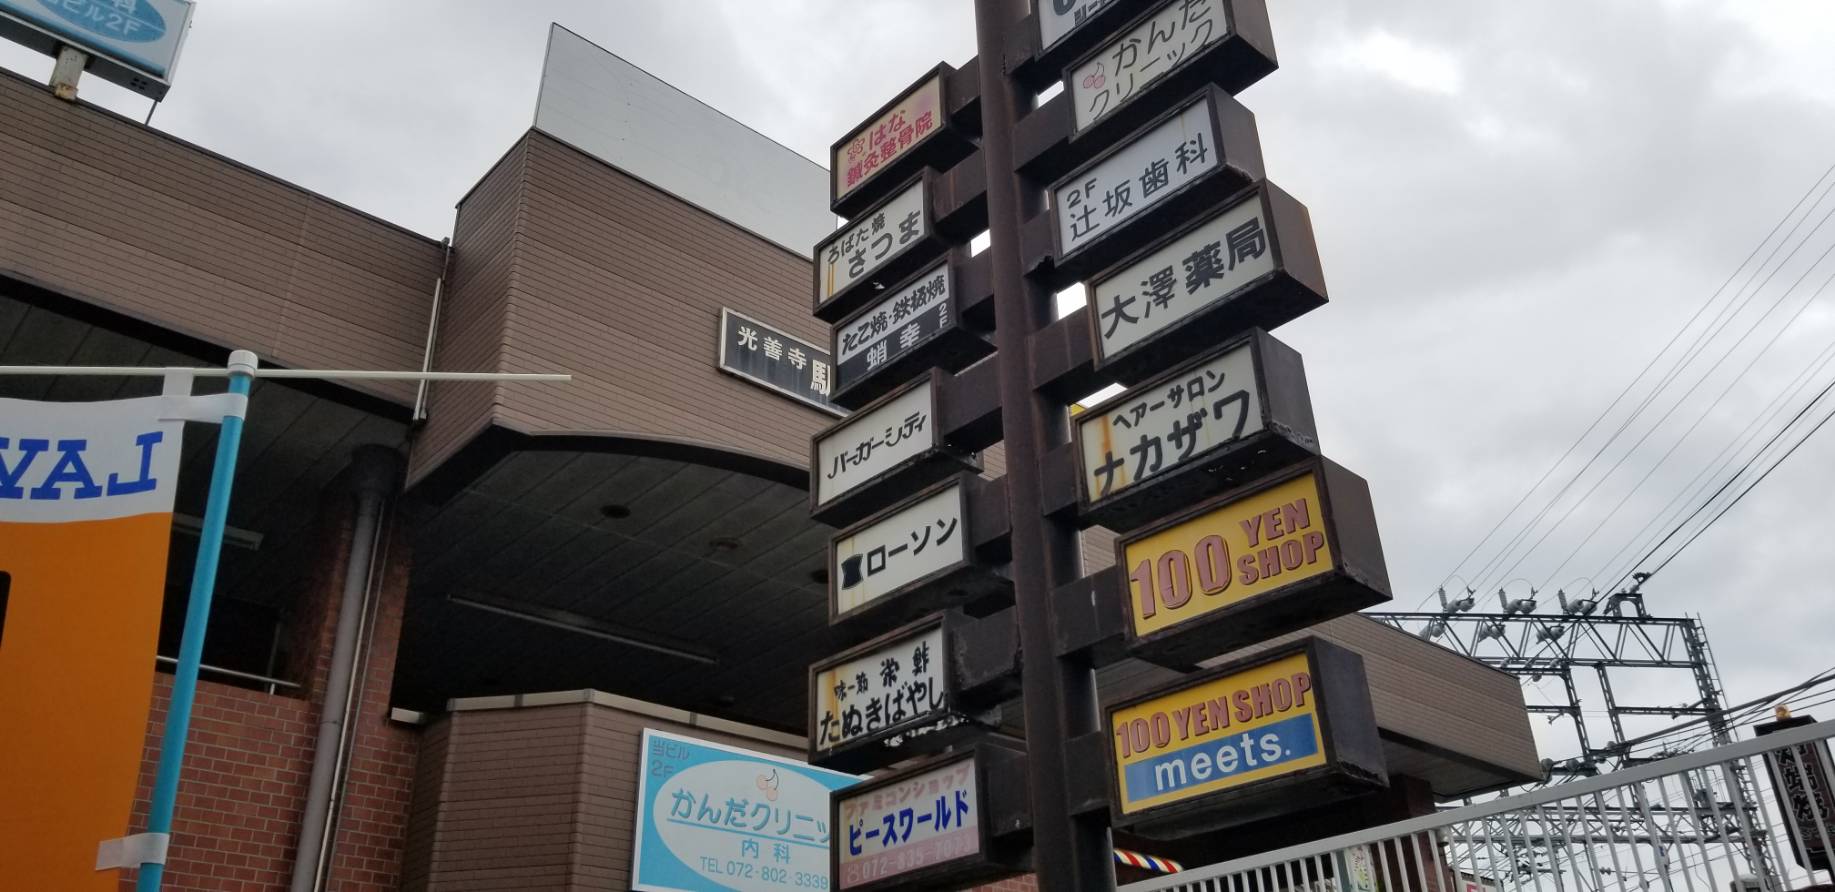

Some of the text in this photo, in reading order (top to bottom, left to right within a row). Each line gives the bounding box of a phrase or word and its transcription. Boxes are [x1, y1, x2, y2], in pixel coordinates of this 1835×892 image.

[1112, 0, 1211, 76] かんだ
[868, 110, 906, 150] はな
[1066, 177, 1097, 209] 2F
[1069, 132, 1208, 242] 辻坂歯科
[848, 210, 921, 279] さつま
[1101, 216, 1267, 340] 大澤薬局
[1112, 370, 1226, 429] ヘアーサロン
[827, 411, 928, 480] バーガーシティ
[1093, 389, 1250, 498] ナカザワ
[867, 517, 958, 578] ローソン
[1239, 498, 1311, 548] YEN
[1130, 534, 1232, 620] 100
[1236, 531, 1325, 586] SHOP
[819, 677, 945, 746] たぬきばやし
[1116, 672, 1312, 759] 100 YEN SHOP
[651, 759, 675, 778] 2F
[1155, 732, 1291, 792] meets.
[849, 790, 969, 856] ピースワールド
[699, 856, 723, 874] TEL
